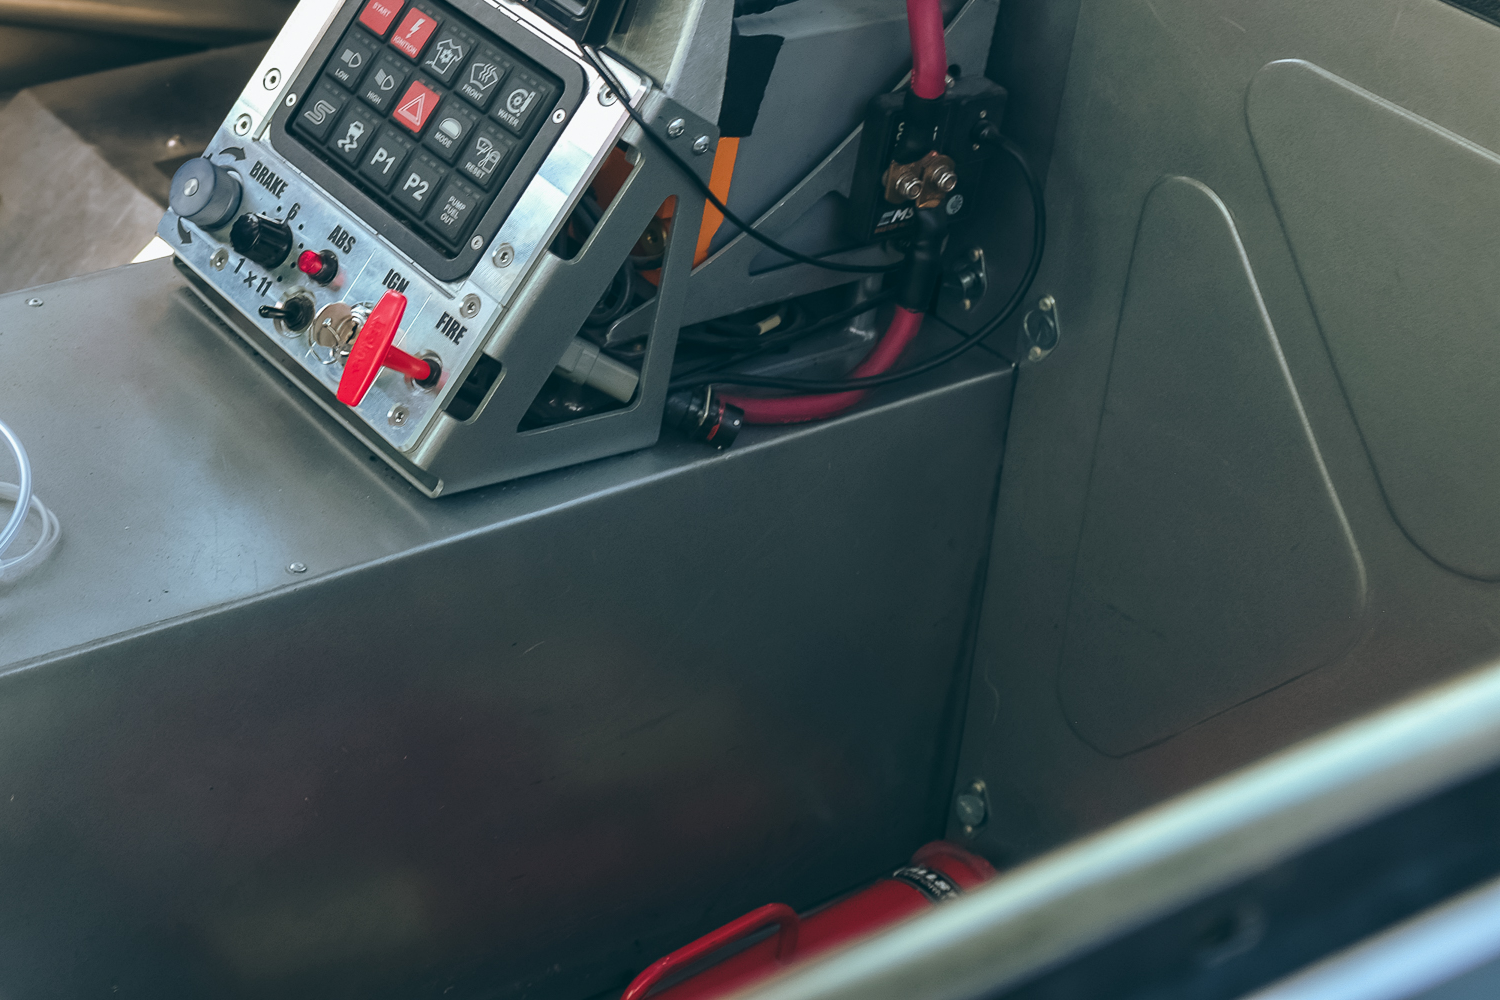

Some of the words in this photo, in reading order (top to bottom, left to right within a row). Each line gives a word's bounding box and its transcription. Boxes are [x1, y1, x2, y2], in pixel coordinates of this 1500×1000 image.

[371, 1, 392, 18] START
[392, 34, 418, 55] IGNITION
[334, 68, 350, 82] LOW
[366, 90, 382, 105] HIGH
[461, 83, 484, 101] FRONT
[497, 107, 520, 128] WATER
[433, 131, 453, 149] MODE
[369, 147, 396, 175] P1
[464, 161, 487, 179] RESET
[249, 160, 289, 200] BRAKE
[402, 172, 430, 201] P2
[287, 202, 301, 221] 6
[443, 203, 459, 220] FUEL
[447, 195, 467, 211] PUMP
[440, 212, 456, 226] OUT
[327, 224, 357, 255] ABS
[382, 268, 410, 293] IGN
[435, 311, 468, 346] FIRE
